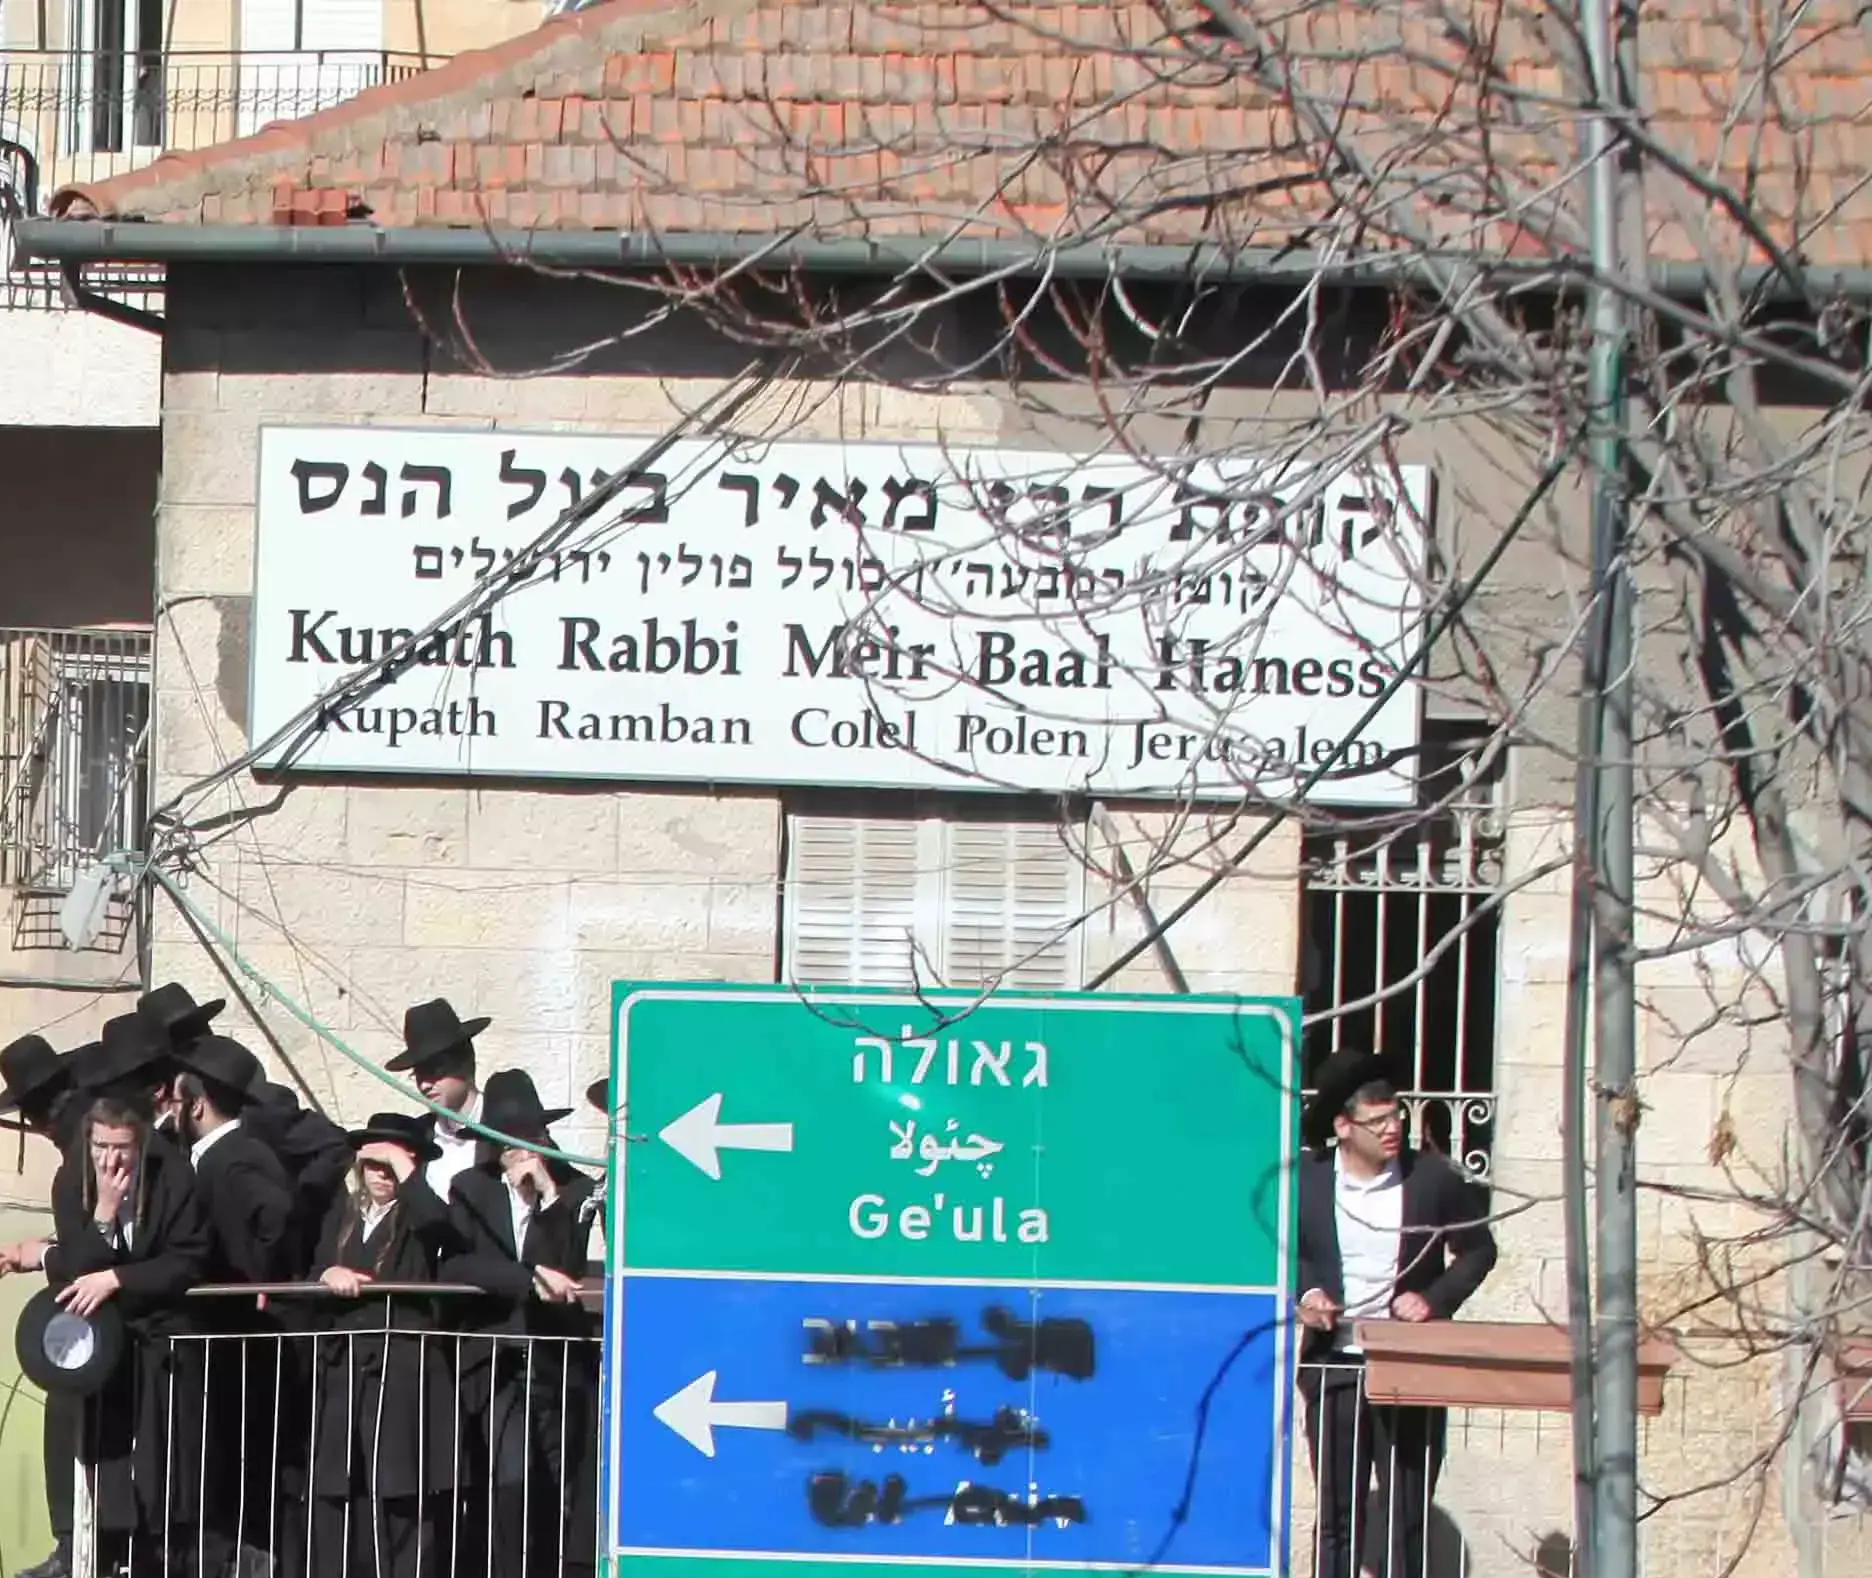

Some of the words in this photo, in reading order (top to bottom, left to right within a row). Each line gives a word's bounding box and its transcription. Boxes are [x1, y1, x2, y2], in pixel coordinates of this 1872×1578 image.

[291, 456, 452, 519] הנס
[499, 448, 670, 524] בעל
[718, 471, 939, 531] מאיר
[413, 536, 610, 584] ירושלים
[637, 543, 753, 593] פולין
[778, 545, 885, 592] כולל
[285, 608, 516, 684] Kupath
[557, 616, 741, 676] Rabbi
[781, 623, 936, 682] Meir
[975, 630, 1113, 690] Baal
[1156, 637, 1387, 699] Haness
[315, 697, 497, 747] Kupath
[536, 700, 753, 744] Ramban
[791, 708, 918, 752] Colel
[953, 714, 1091, 758] Polen
[1127, 722, 1387, 768] Jerusalem
[853, 1023, 1049, 1088] גאולה
[848, 1192, 1049, 1243] Ge'ula
